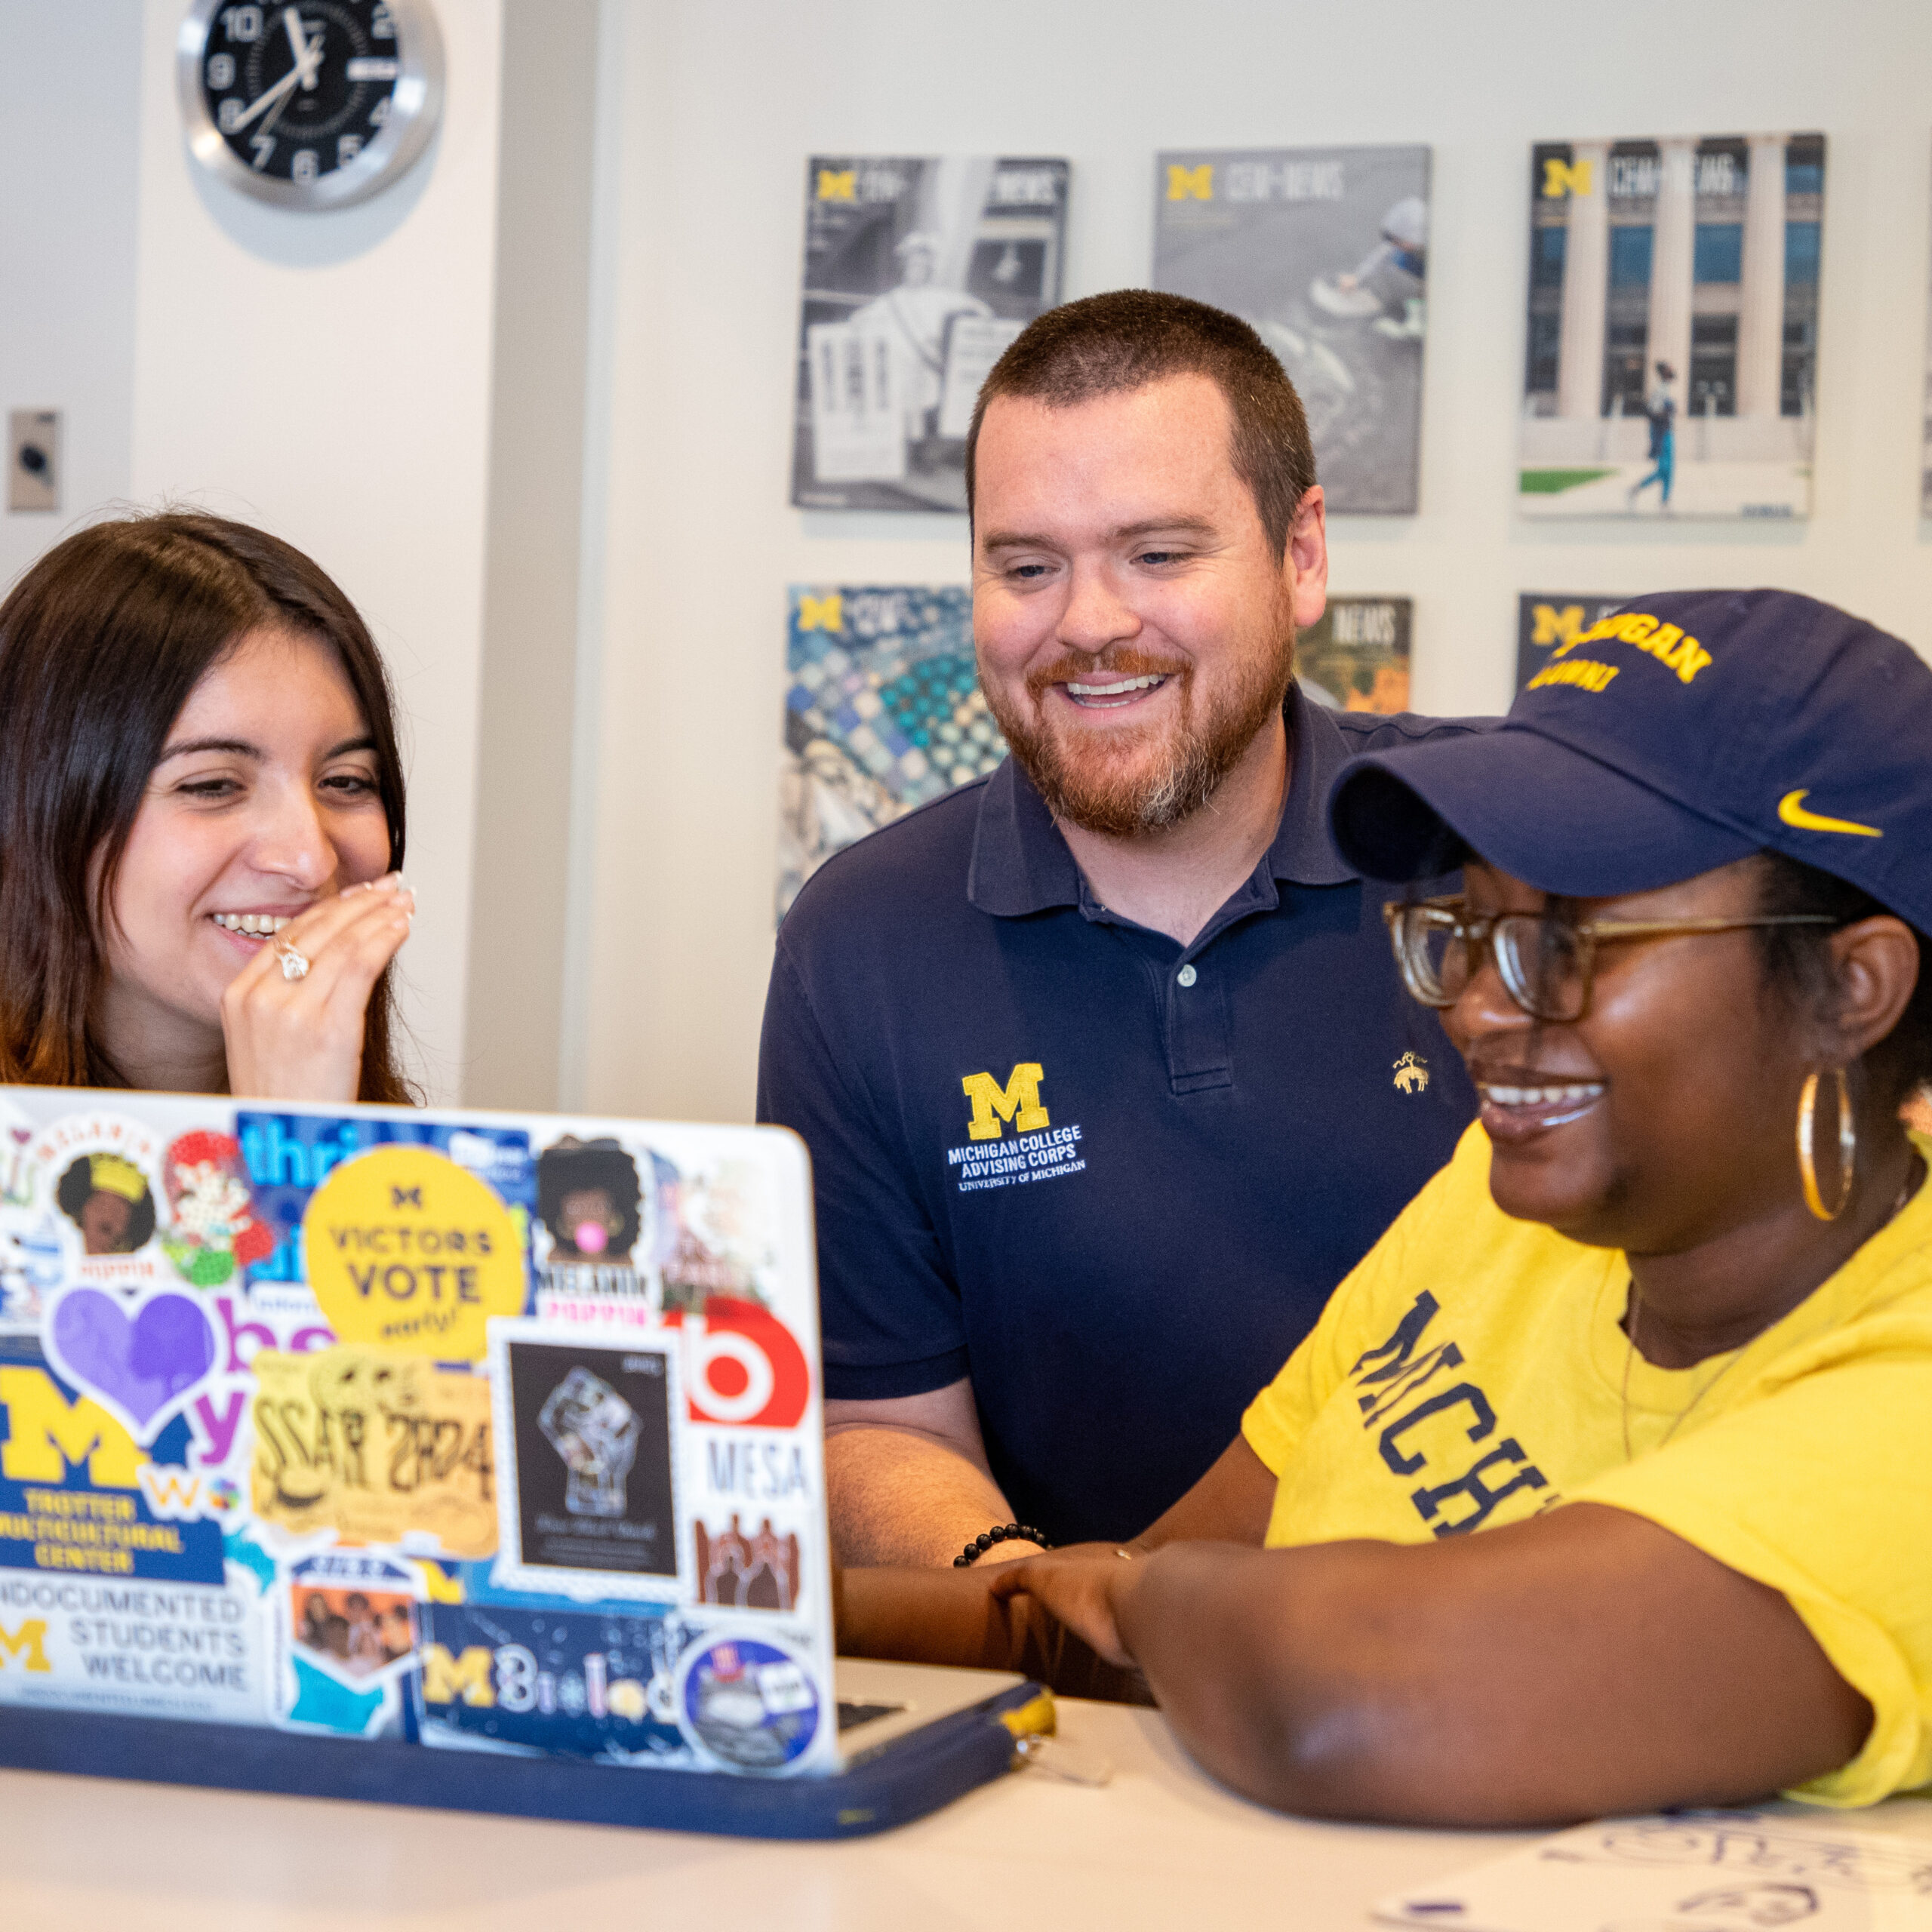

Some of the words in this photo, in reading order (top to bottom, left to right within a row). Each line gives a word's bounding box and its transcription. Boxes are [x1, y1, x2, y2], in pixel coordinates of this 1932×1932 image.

[219, 5, 263, 42] 10
[1168, 165, 1214, 200] M
[1333, 605, 1395, 645] NEWS
[962, 1063, 1050, 1140] M
[948, 1140, 1019, 1164] MICHIGAN
[1019, 1125, 1082, 1152] COLLEGE
[962, 1155, 1026, 1178] ADVISING
[1029, 1143, 1076, 1167] CORPS
[329, 1226, 494, 1256] VICTORS
[346, 1263, 482, 1305] VOTE
[0, 1363, 151, 1489] M
[23, 1488, 137, 1521] TROTTER
[35, 1543, 134, 1573] CENTER
[69, 1618, 246, 1659] STUDENTS
[80, 1653, 248, 1693] WELCOME
